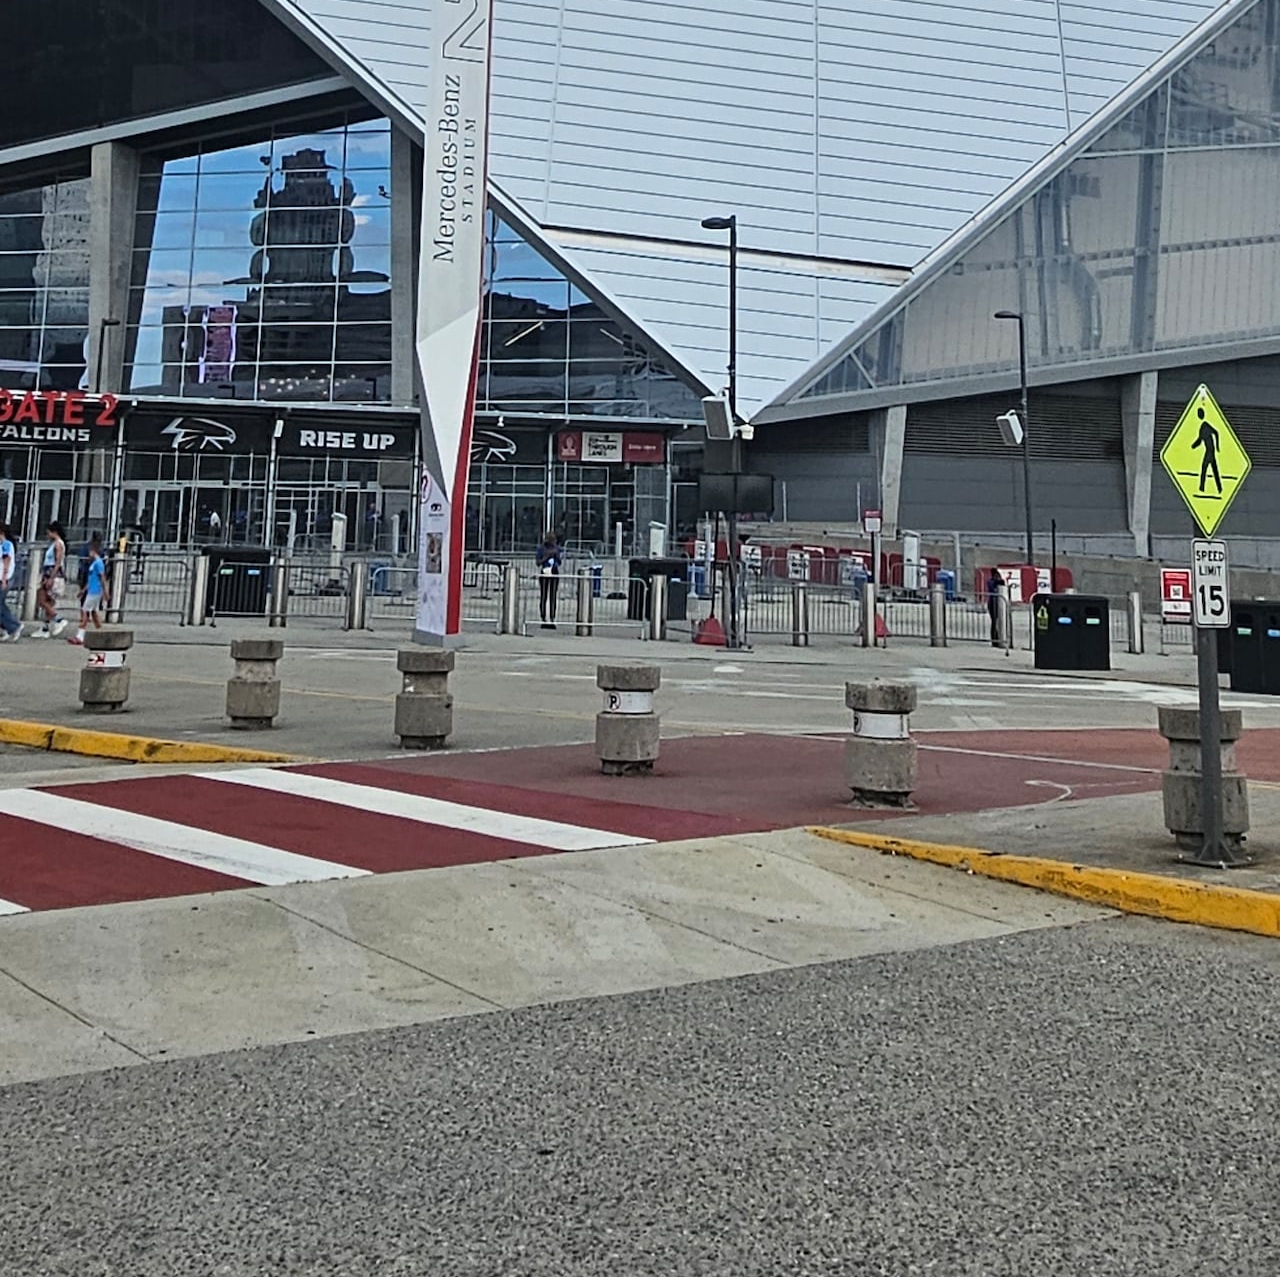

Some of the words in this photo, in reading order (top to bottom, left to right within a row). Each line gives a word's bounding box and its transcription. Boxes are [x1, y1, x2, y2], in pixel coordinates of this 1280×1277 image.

[432, 74, 461, 263] Mercedes-Benz
[461, 118, 477, 223] STADIUM
[95, 392, 119, 426] 2
[300, 430, 357, 449] RISE
[363, 433, 396, 450] UP
[1196, 550, 1224, 562] SPEED
[1199, 565, 1222, 577] LIMIT
[1199, 584, 1225, 617] 15
